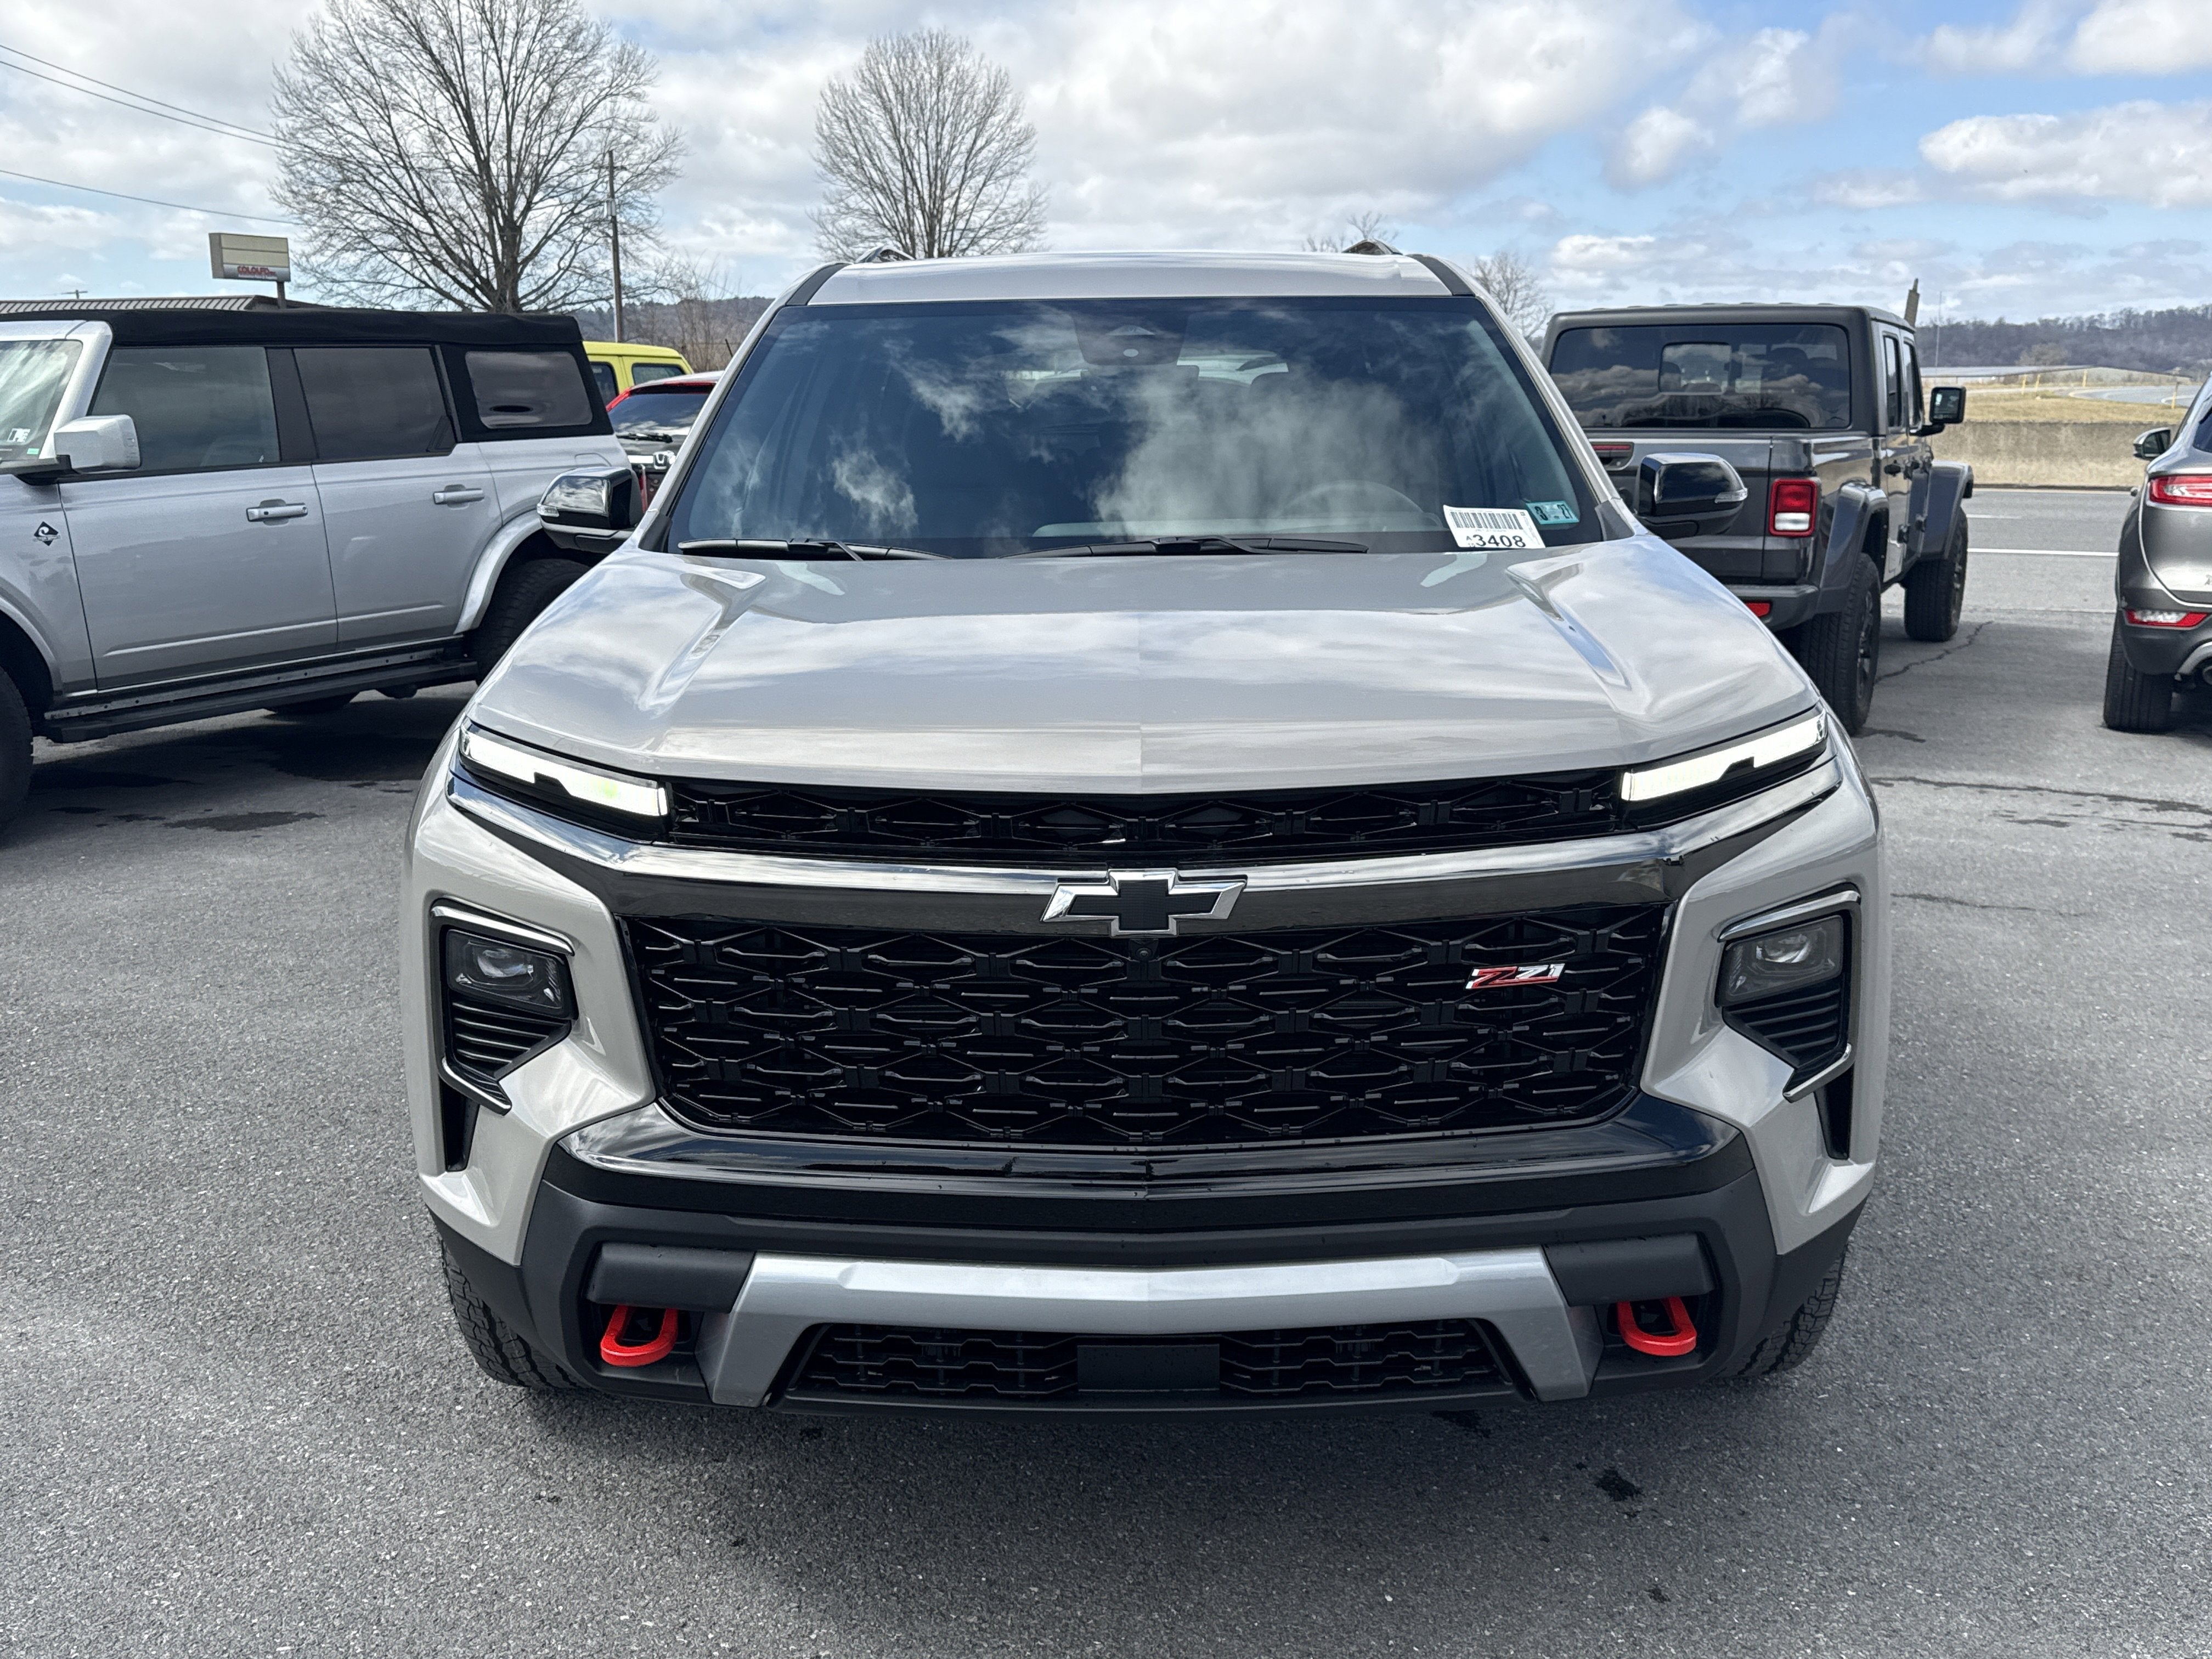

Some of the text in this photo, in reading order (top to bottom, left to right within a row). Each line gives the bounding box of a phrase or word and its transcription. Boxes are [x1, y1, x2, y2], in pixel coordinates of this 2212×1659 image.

[1534, 504, 1573, 521] 3 27
[1472, 534, 1526, 548] 3408
[1465, 963, 1565, 989] Z71
